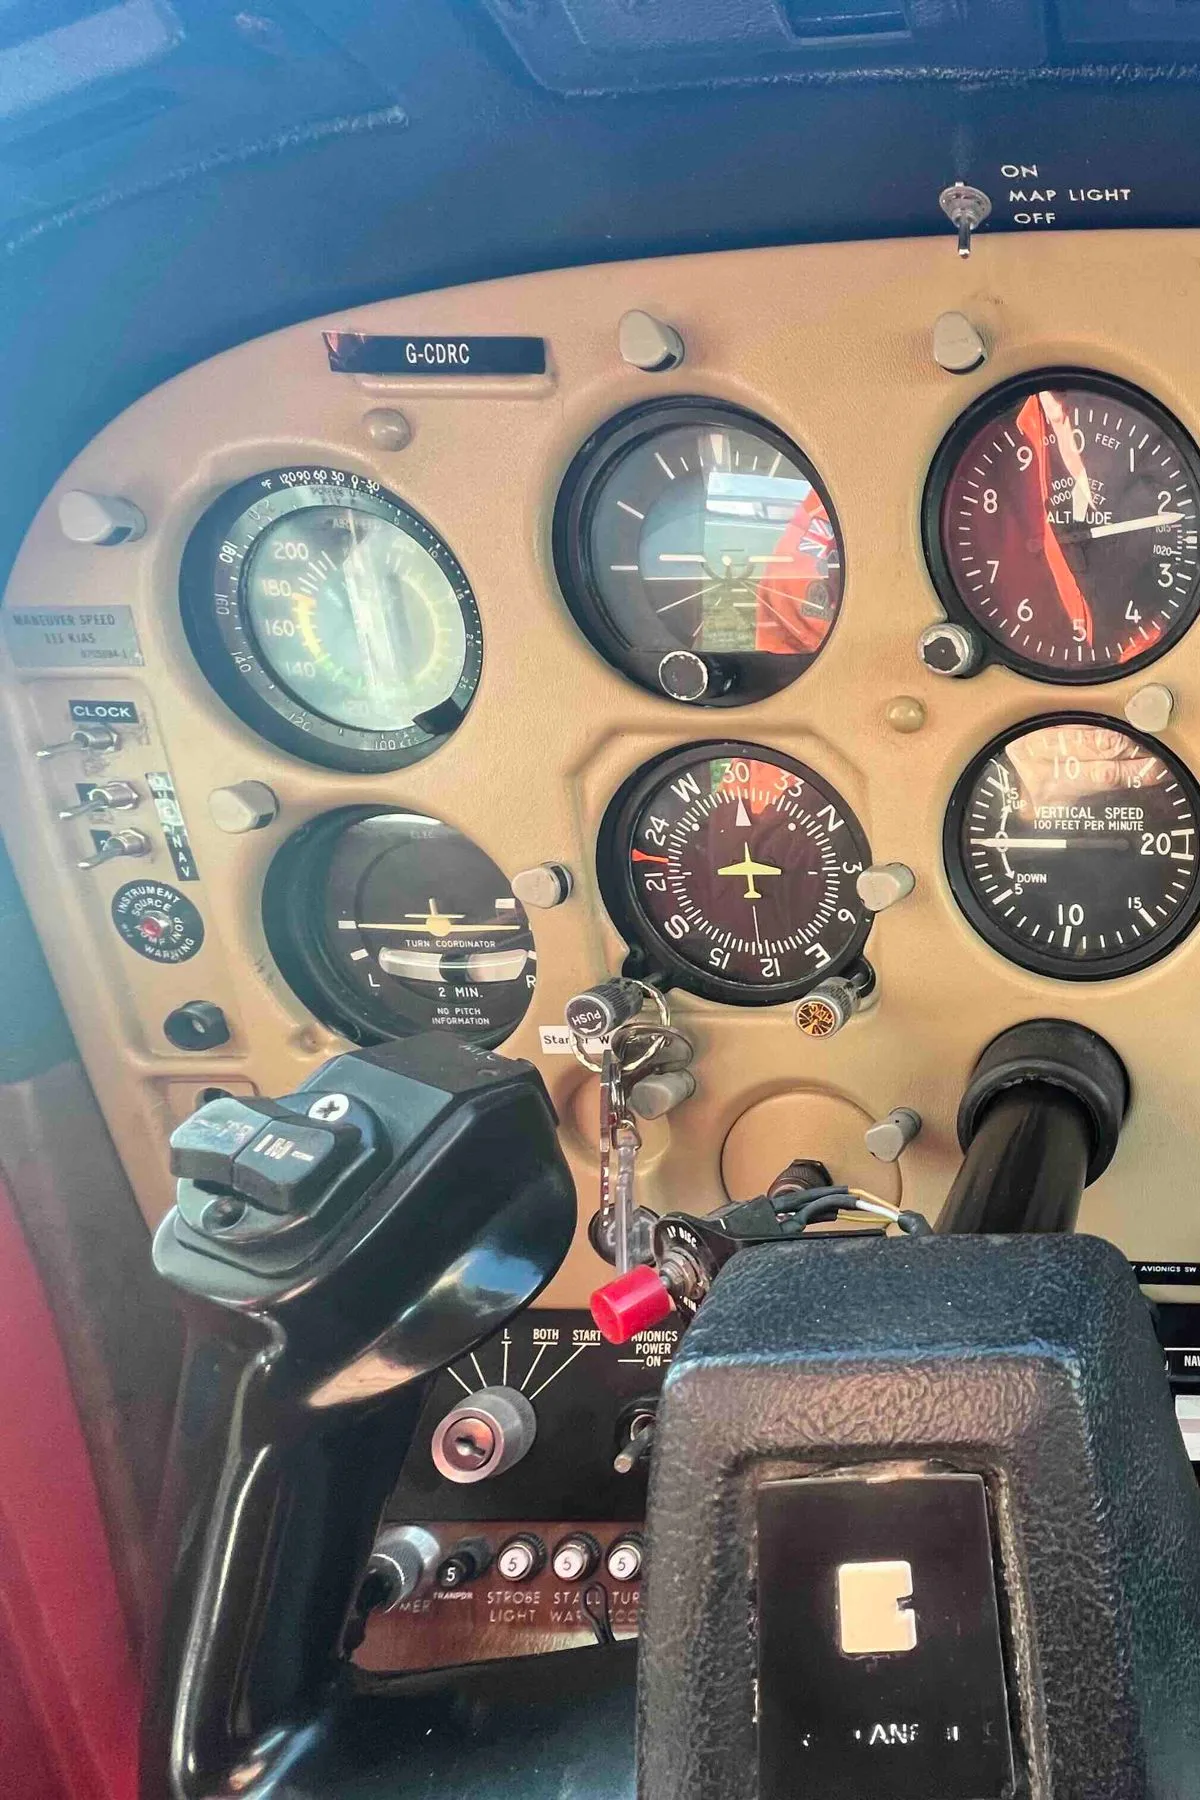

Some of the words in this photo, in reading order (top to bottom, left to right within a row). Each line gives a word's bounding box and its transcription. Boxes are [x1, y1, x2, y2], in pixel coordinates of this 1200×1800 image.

[1001, 164, 1038, 178] ON
[1009, 189, 1056, 201] MAP
[1068, 189, 1131, 201] LIGHT
[1013, 212, 1056, 224] OFF
[406, 343, 469, 364] G-CDRC
[1094, 432, 1122, 451] FEET
[1016, 446, 1033, 472] 9
[313, 469, 328, 481] 60
[1157, 563, 1174, 588] 3
[1017, 598, 1034, 622] 6
[265, 621, 295, 638] 160
[73, 705, 131, 718] CLOCK
[720, 762, 751, 784] 30
[1033, 806, 1095, 819] VERTICAL
[1104, 807, 1144, 820] SPEED
[1033, 820, 1052, 830] 100
[1054, 820, 1081, 831] FEET
[1084, 820, 1104, 831] PER
[1108, 821, 1144, 831] MINUTE
[1140, 832, 1172, 856] 20
[1017, 873, 1047, 884] DOWN
[1057, 903, 1084, 926] 10
[405, 939, 431, 948] TURN
[435, 939, 496, 949] COORDINATOR
[760, 957, 781, 978] 12
[367, 973, 381, 988] L
[438, 987, 447, 998] 2
[455, 987, 484, 998] MIN.
[437, 1007, 453, 1015] NO
[455, 1007, 481, 1016] PITCH
[571, 1008, 602, 1027] PUSH
[431, 1017, 491, 1026] INFORMATION
[1141, 1265, 1181, 1273] AVIONICS
[1184, 1265, 1197, 1273] SW
[533, 1328, 560, 1341] BOTH
[572, 1330, 602, 1342] START
[631, 1330, 678, 1342] AVIONICS
[635, 1343, 672, 1355] POWER
[646, 1356, 661, 1368] ON
[487, 1591, 541, 1605] STROBE
[489, 1610, 538, 1623] LIGHT
